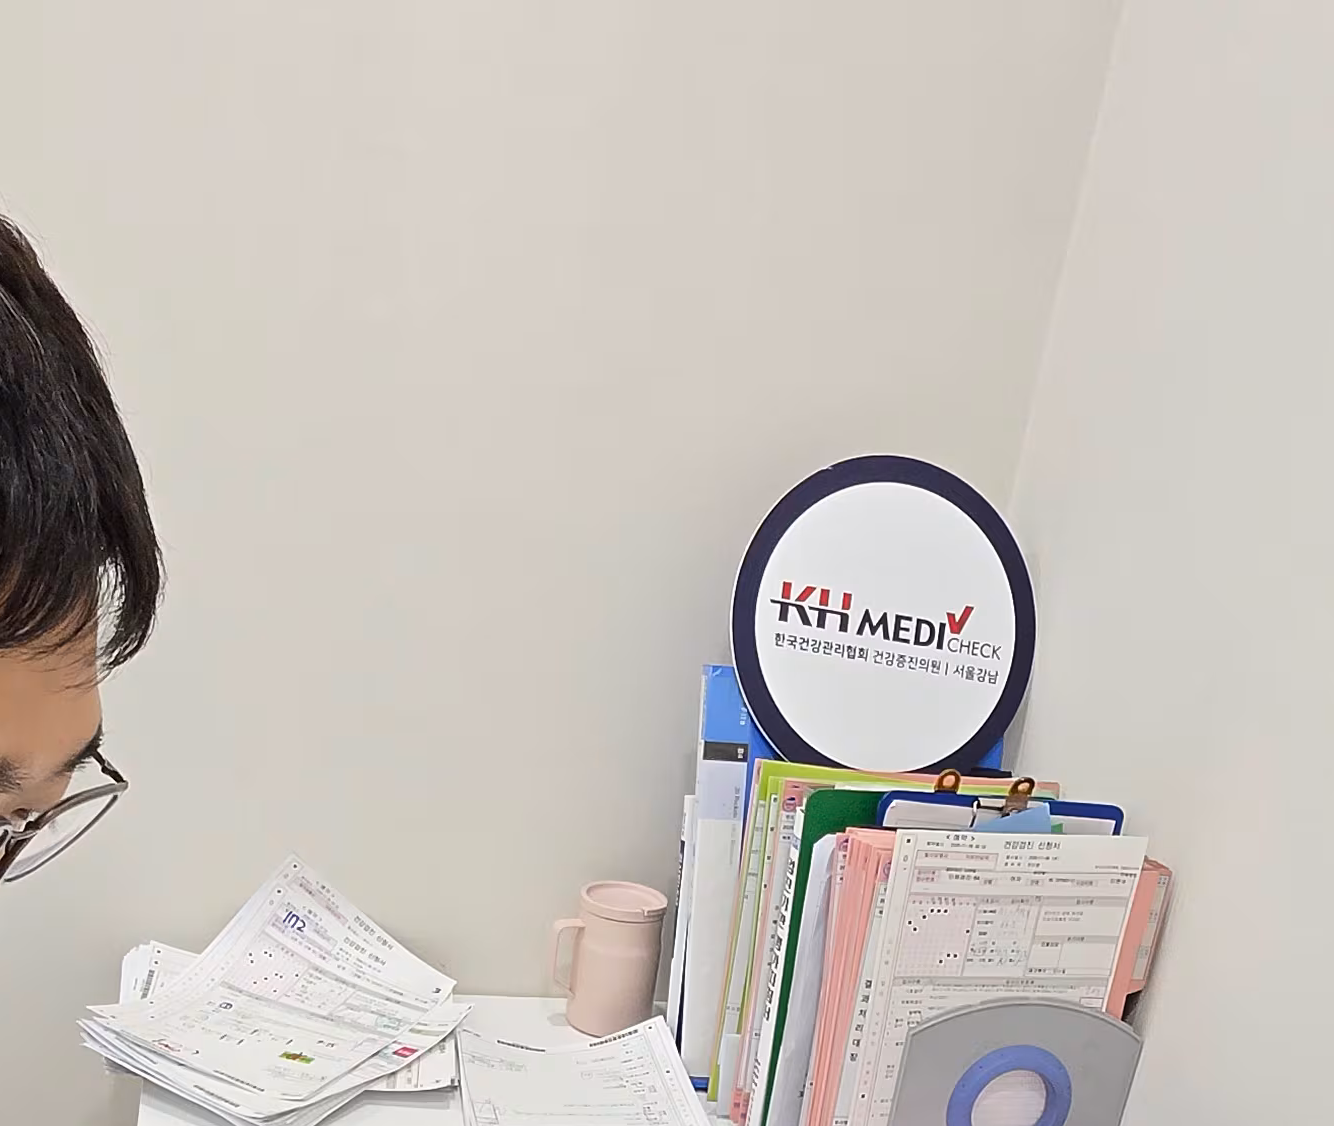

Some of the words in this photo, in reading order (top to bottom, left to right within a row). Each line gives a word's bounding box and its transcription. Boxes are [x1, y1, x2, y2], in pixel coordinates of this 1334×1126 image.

[770, 581, 852, 633] KH
[775, 632, 869, 662] 한국건강관리협회
[873, 651, 941, 675] 건강증진의원
[953, 663, 999, 685] 서울강남
